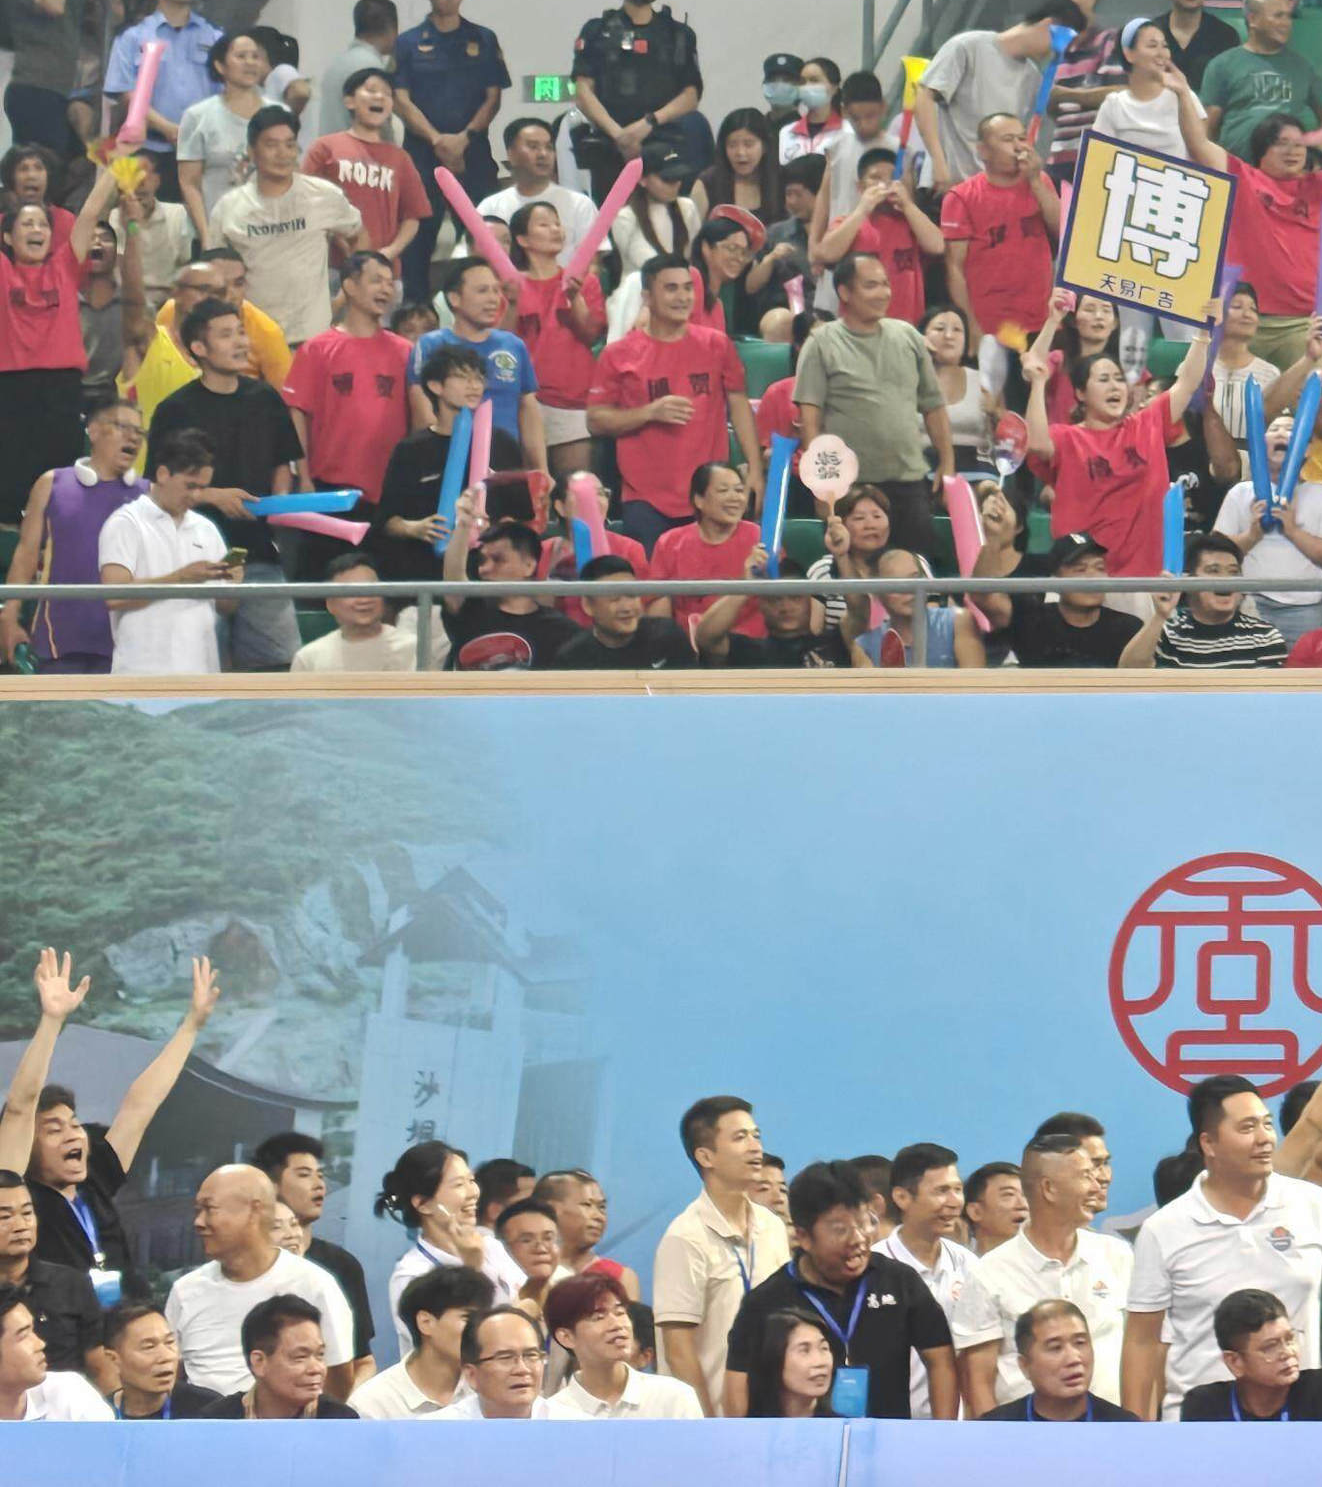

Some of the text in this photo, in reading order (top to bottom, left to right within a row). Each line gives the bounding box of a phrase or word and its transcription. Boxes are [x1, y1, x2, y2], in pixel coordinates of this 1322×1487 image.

[1097, 151, 1211, 280] 博
[1100, 273, 1174, 309] 天易广告
